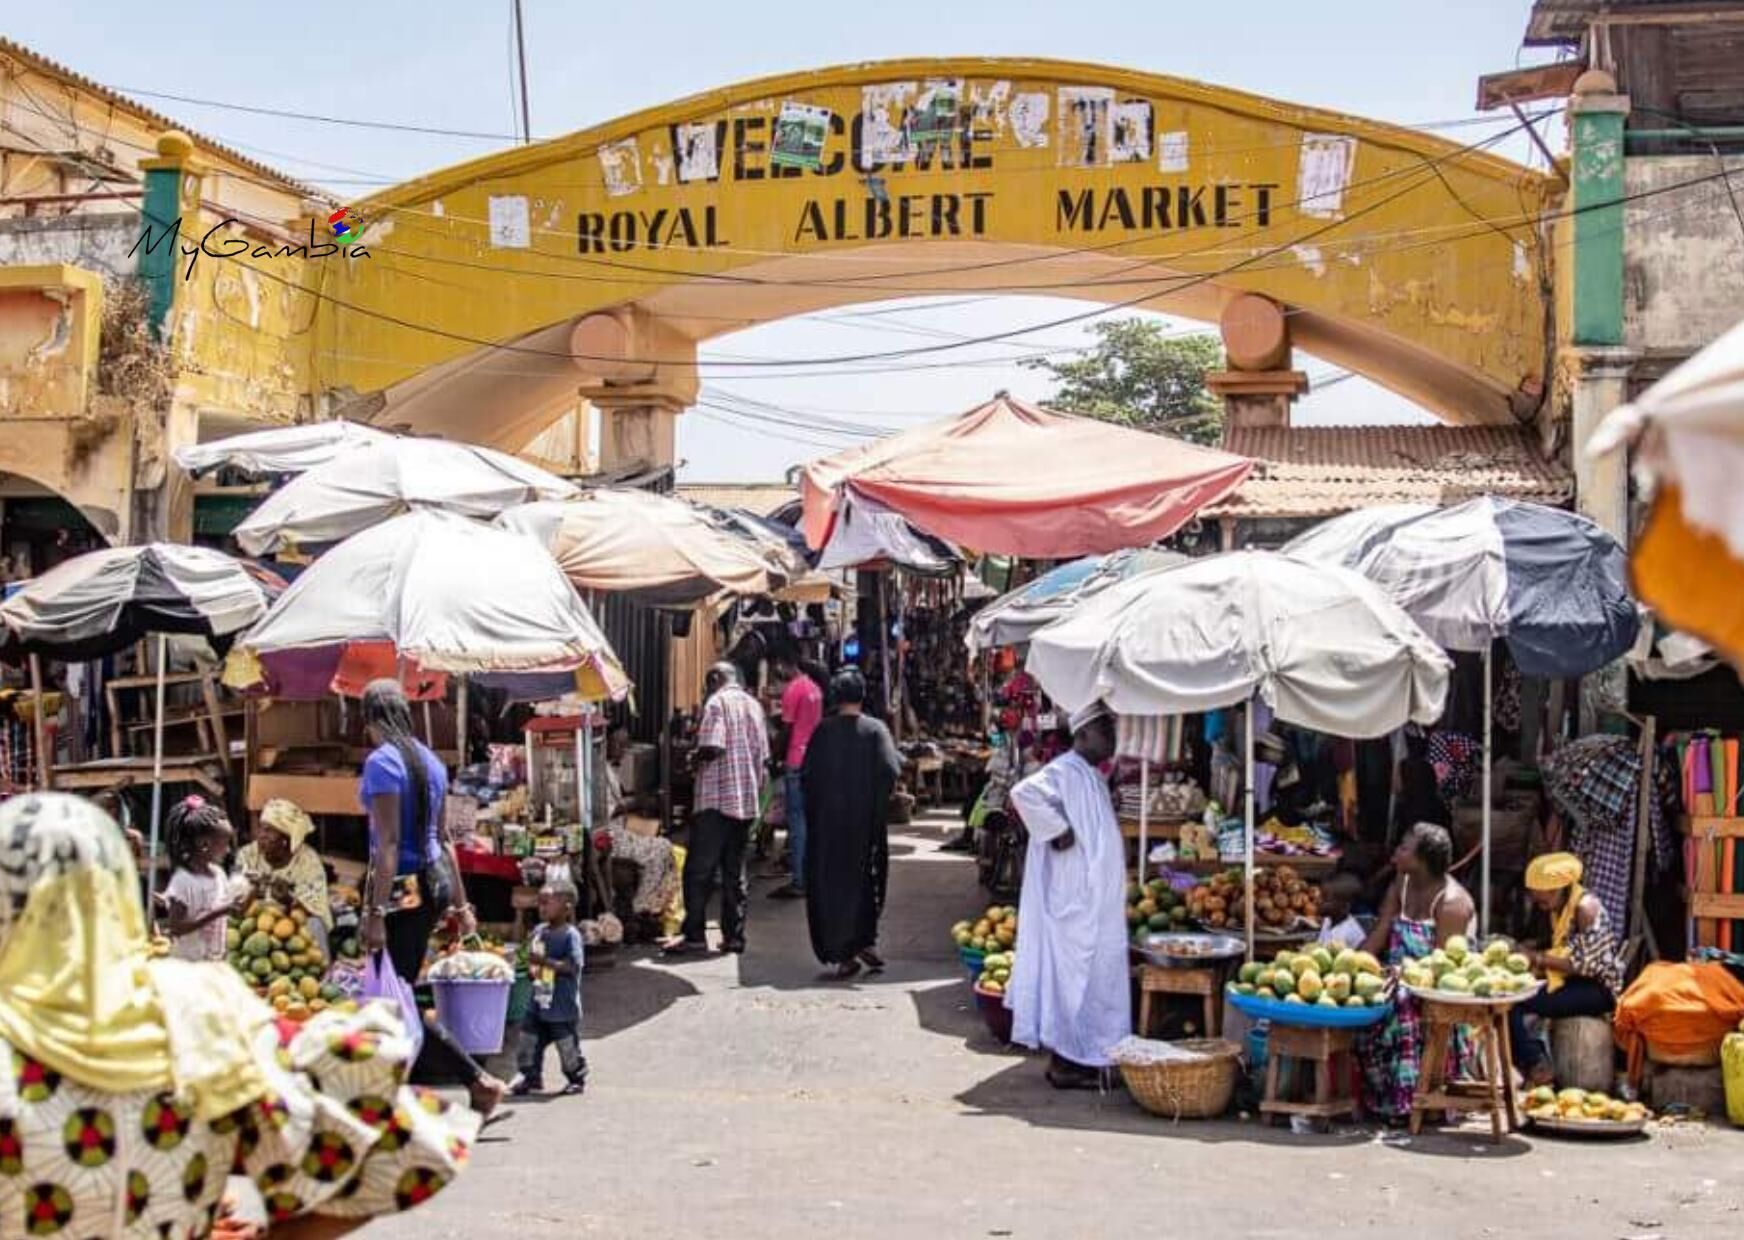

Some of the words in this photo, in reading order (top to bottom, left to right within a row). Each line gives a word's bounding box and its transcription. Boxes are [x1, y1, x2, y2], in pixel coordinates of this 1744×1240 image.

[578, 206, 729, 254] ROYAL
[796, 193, 993, 241] ALBERT
[1057, 184, 1278, 232] MARKET
